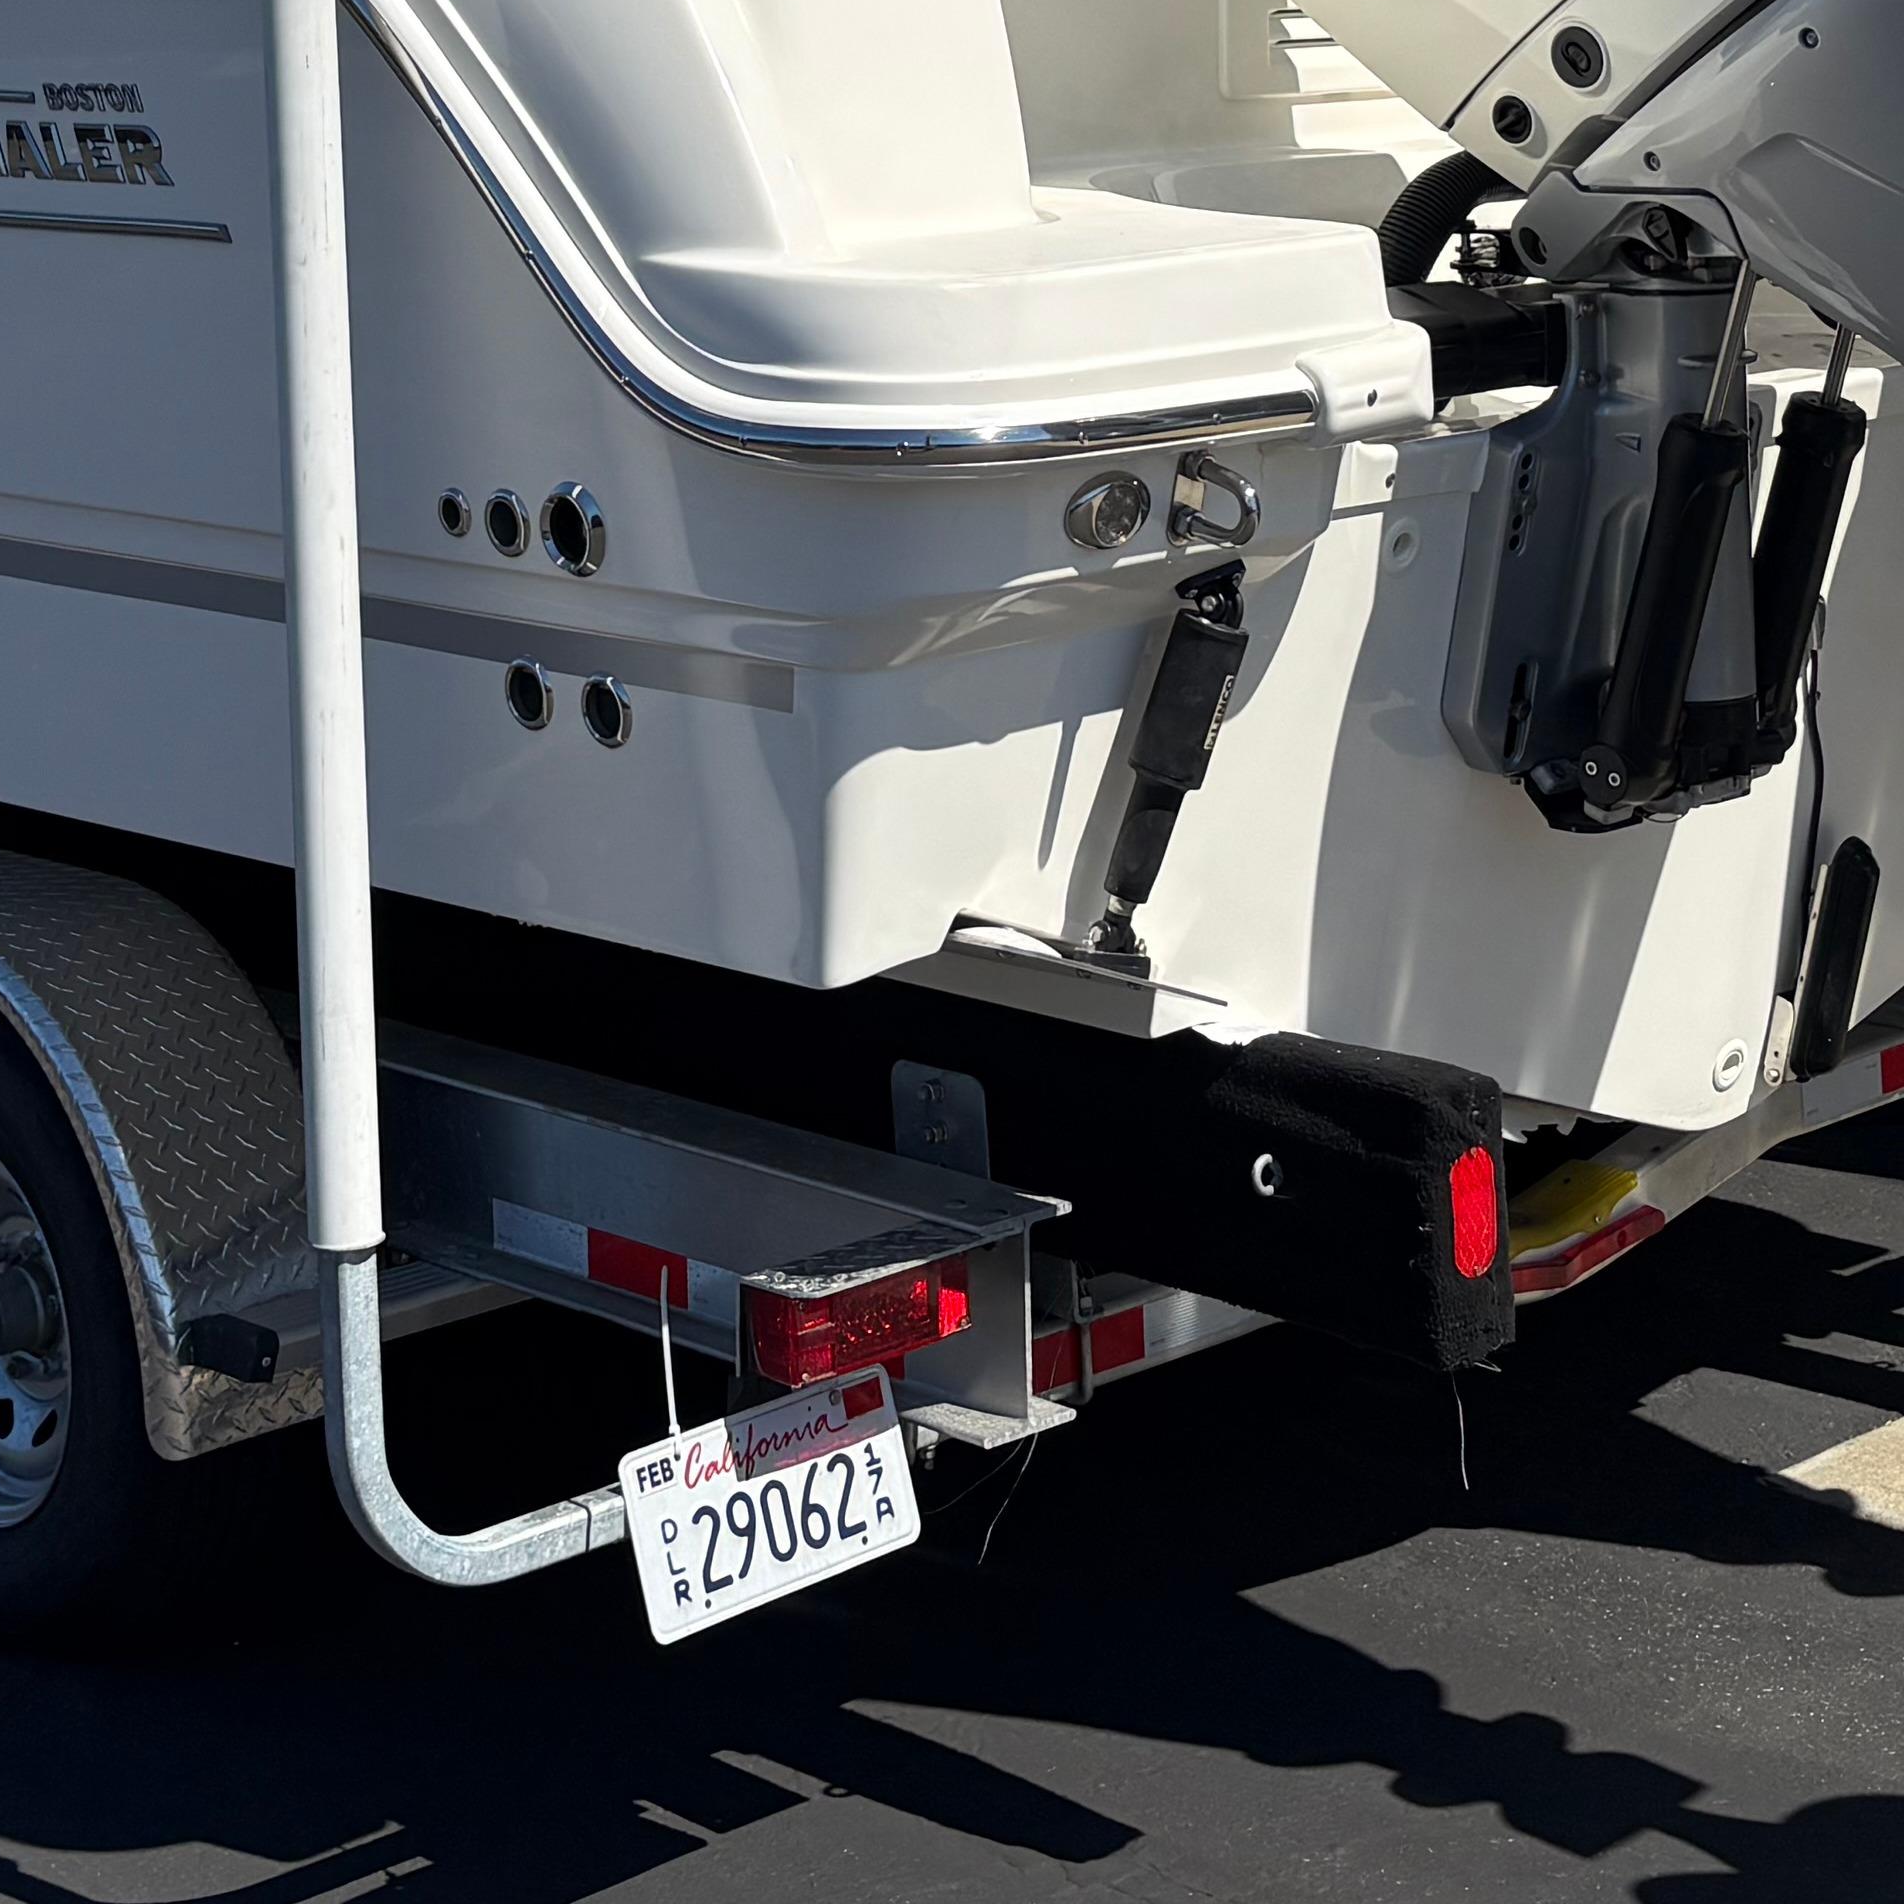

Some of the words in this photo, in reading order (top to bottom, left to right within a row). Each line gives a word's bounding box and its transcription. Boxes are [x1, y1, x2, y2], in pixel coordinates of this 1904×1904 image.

[42, 82, 145, 113] BOSTON
[636, 1456, 674, 1493] FEB
[684, 1404, 848, 1489] California
[691, 1453, 866, 1594] 29062
